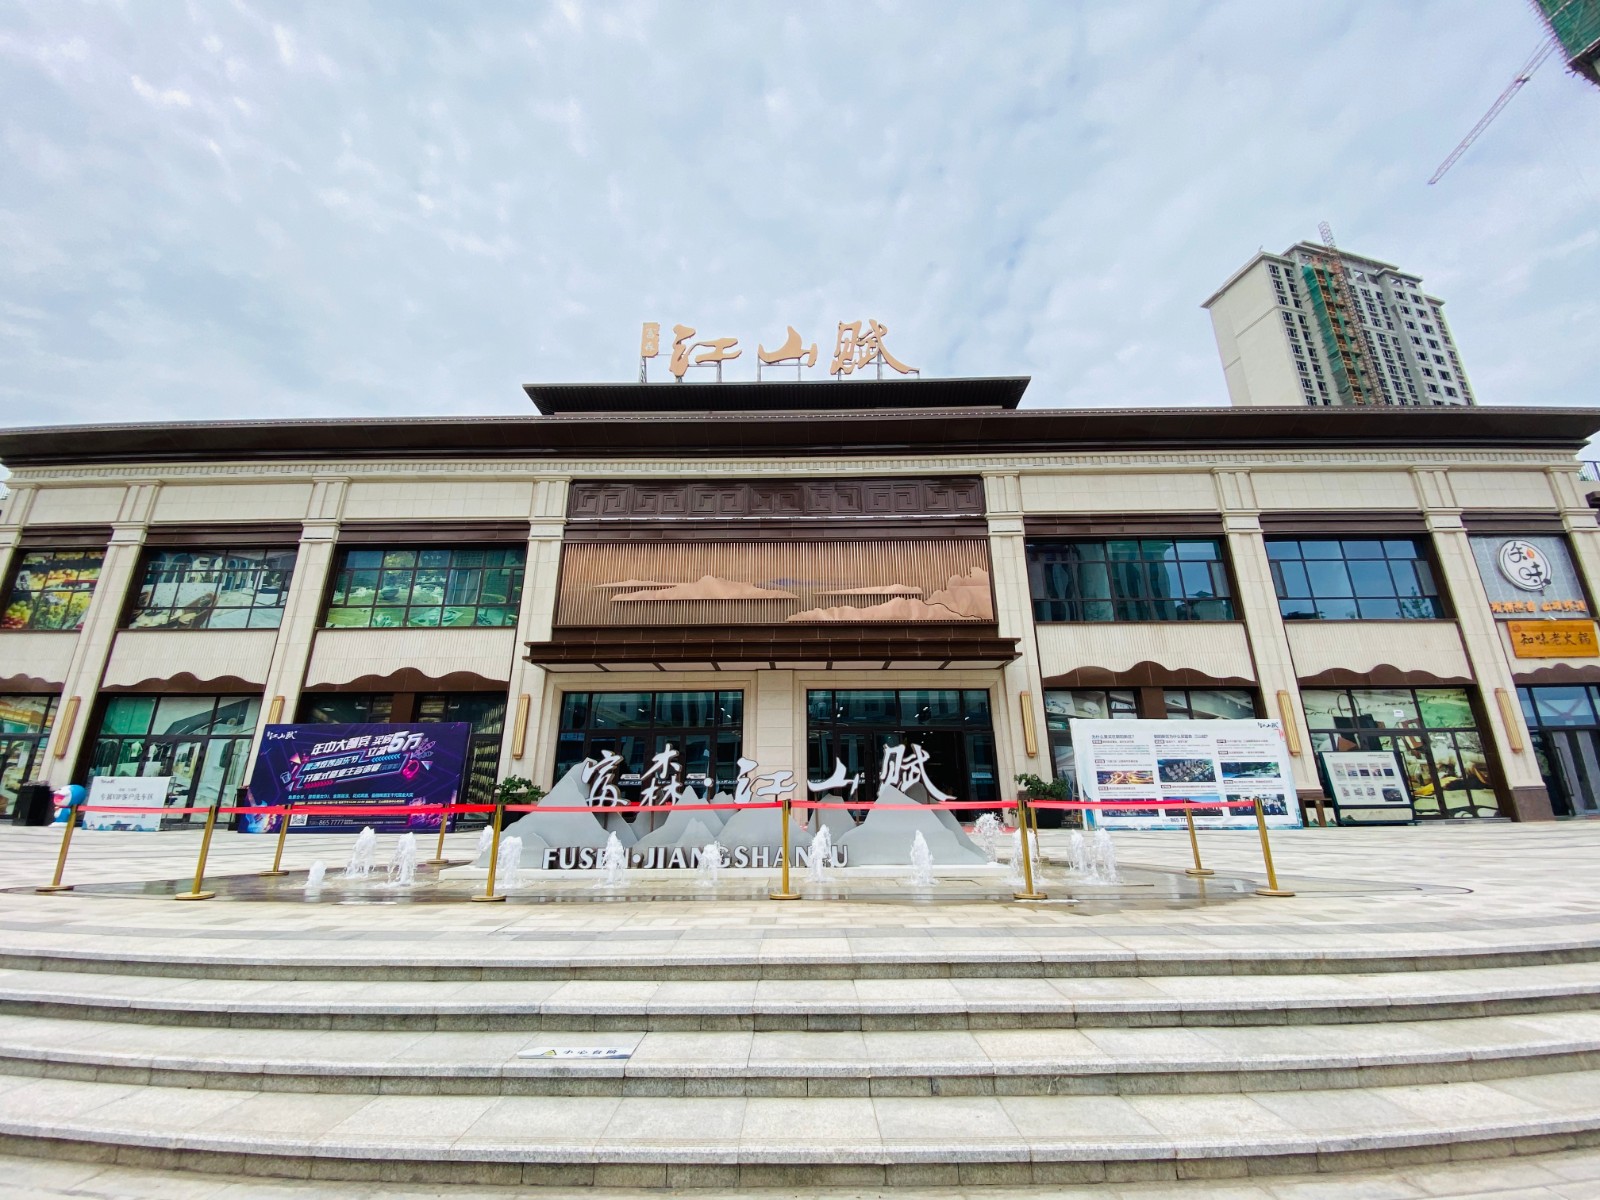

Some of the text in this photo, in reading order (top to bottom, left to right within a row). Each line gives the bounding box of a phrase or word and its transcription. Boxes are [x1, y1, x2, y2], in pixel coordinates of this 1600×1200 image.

[668, 318, 920, 377] 江山赋
[1519, 632, 1592, 647] 知味老火锅
